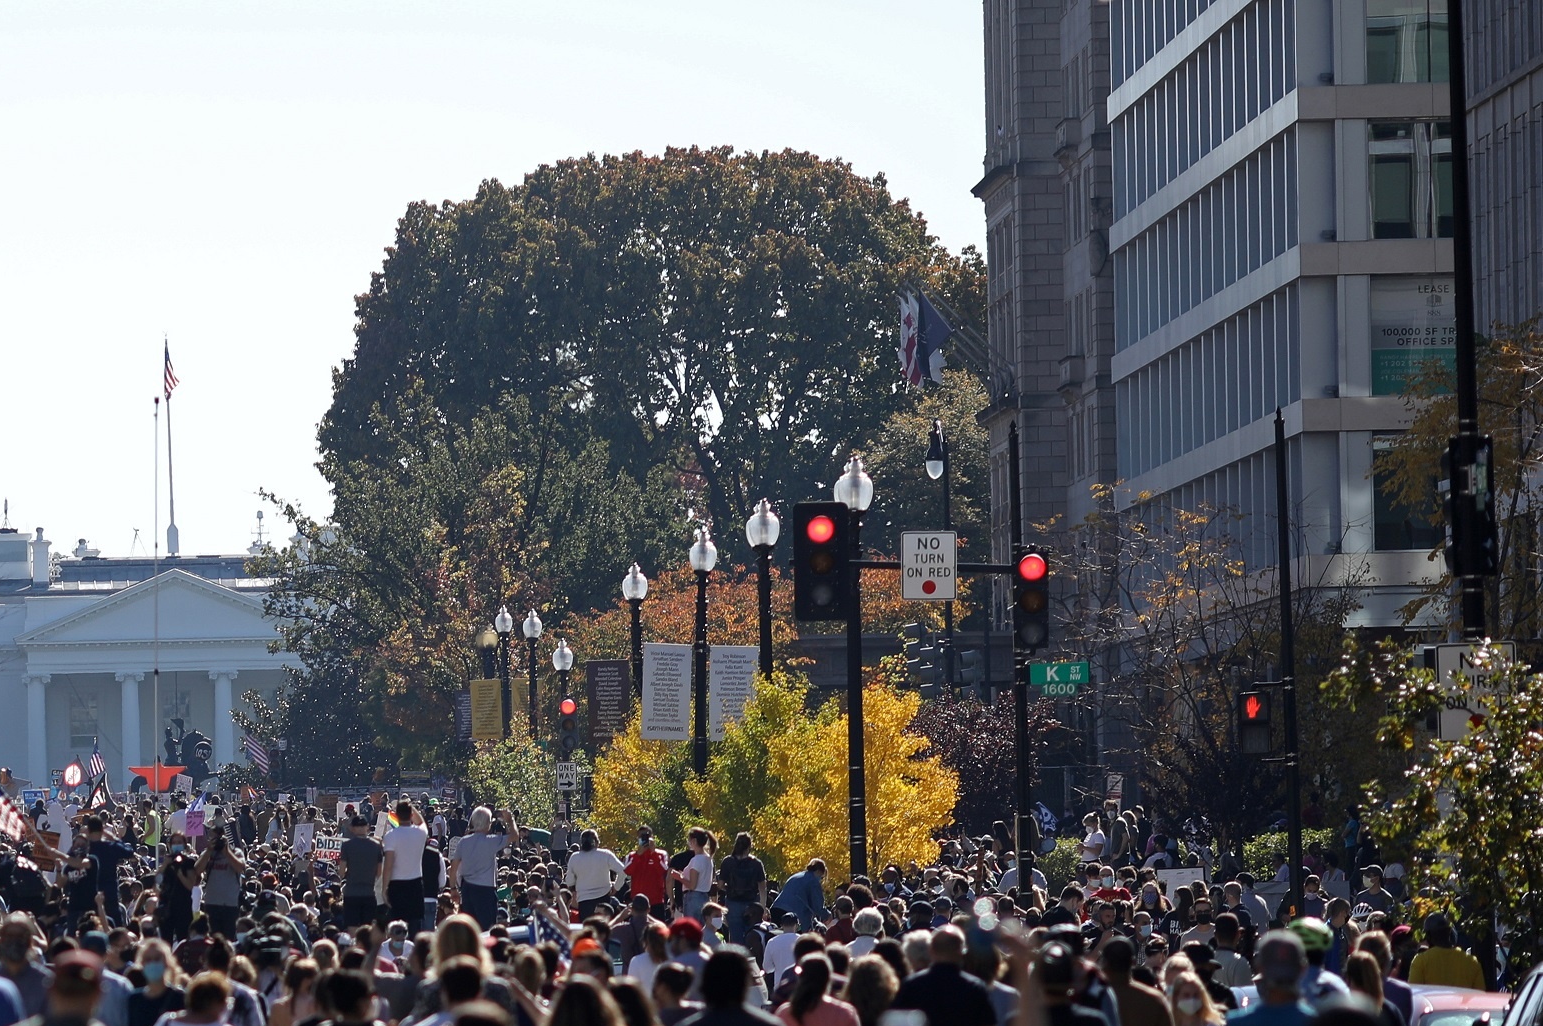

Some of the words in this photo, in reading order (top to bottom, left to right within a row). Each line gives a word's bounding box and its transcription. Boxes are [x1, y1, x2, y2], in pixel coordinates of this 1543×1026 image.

[1418, 285, 1450, 294] LEASE
[1382, 328, 1421, 337] 100,000
[1425, 327, 1438, 336] SF
[1442, 327, 1456, 336] TR
[1397, 337, 1437, 346] OFFICE
[917, 537, 940, 550] NO
[914, 553, 945, 564] TURN
[907, 567, 923, 578] ON
[929, 567, 951, 578] RED
[1046, 666, 1060, 681] K
[1042, 684, 1075, 695] 1600
[558, 764, 574, 772] ONE
[558, 772, 575, 780] WAY
